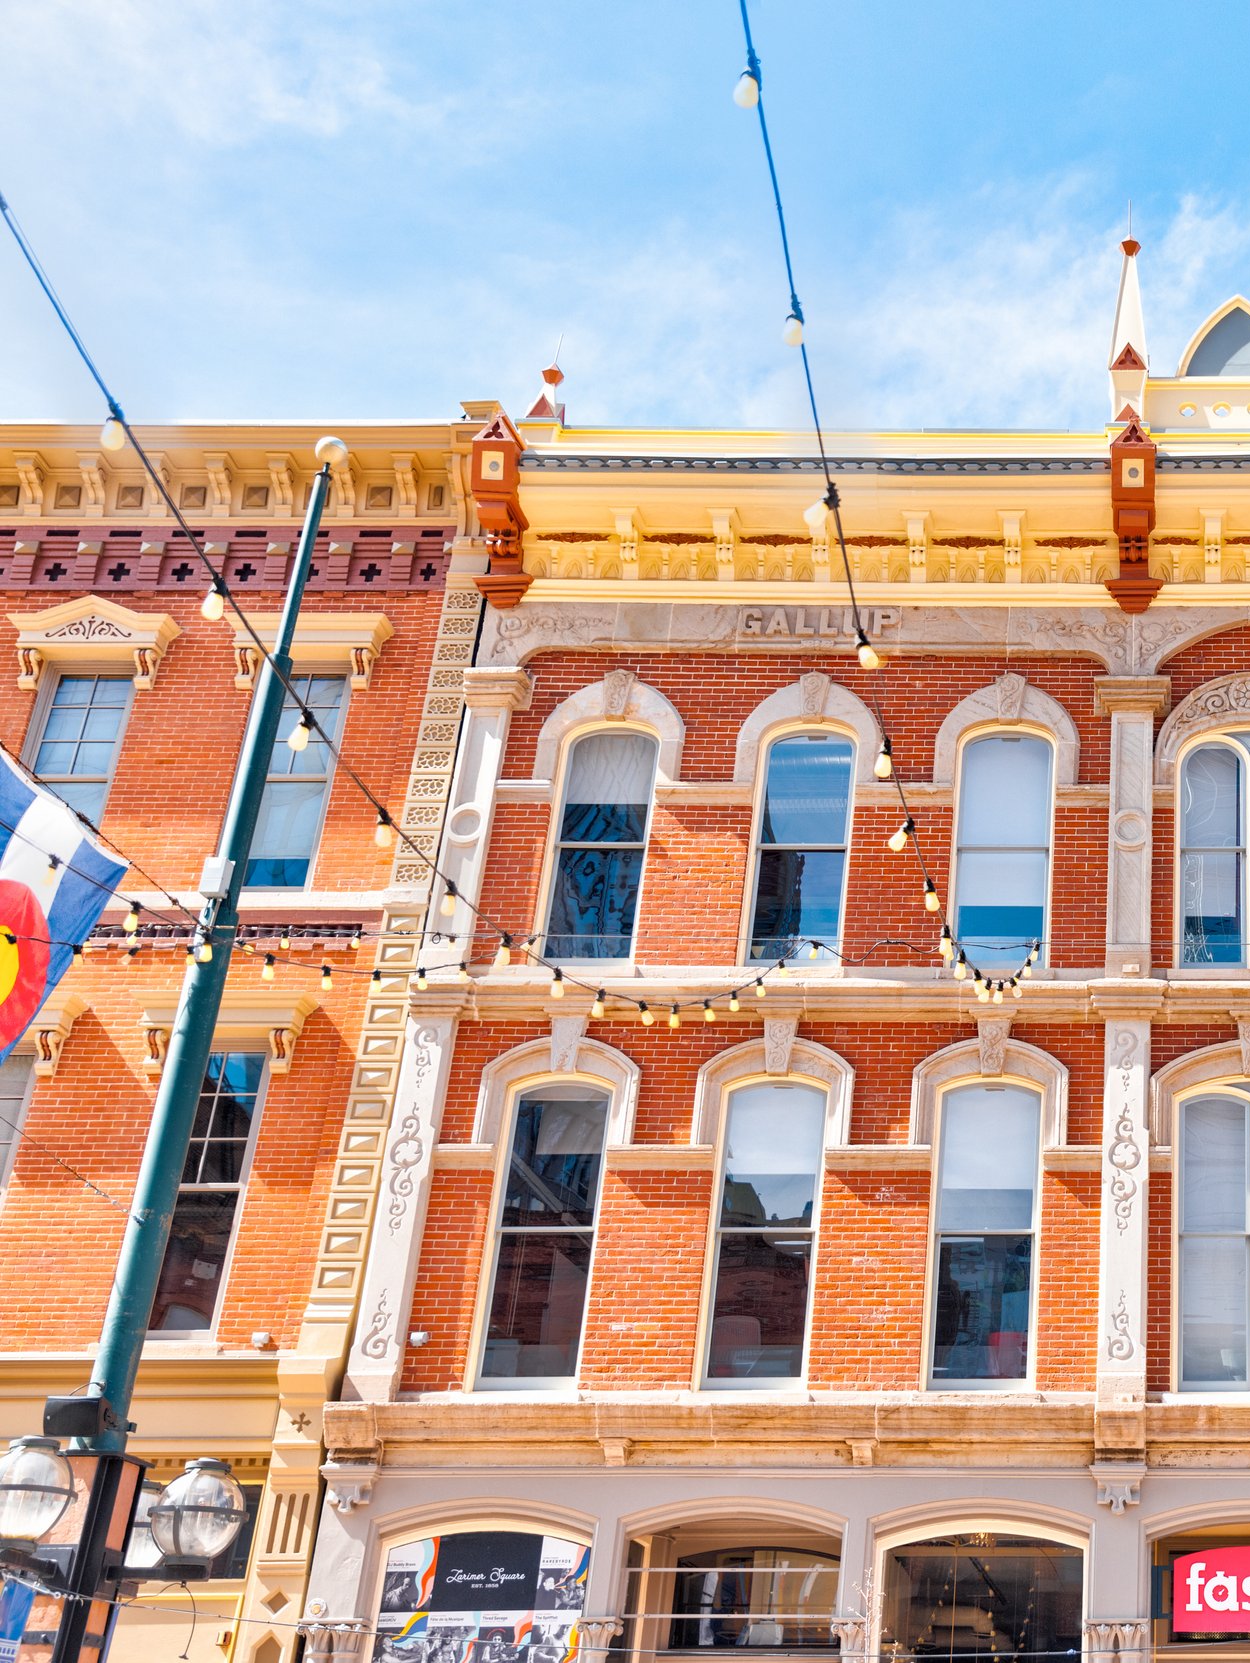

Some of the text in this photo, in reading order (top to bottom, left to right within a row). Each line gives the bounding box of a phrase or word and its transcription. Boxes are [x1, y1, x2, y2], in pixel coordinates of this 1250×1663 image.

[740, 608, 901, 637] GALLUP
[446, 1567, 526, 1584] Larimer Square
